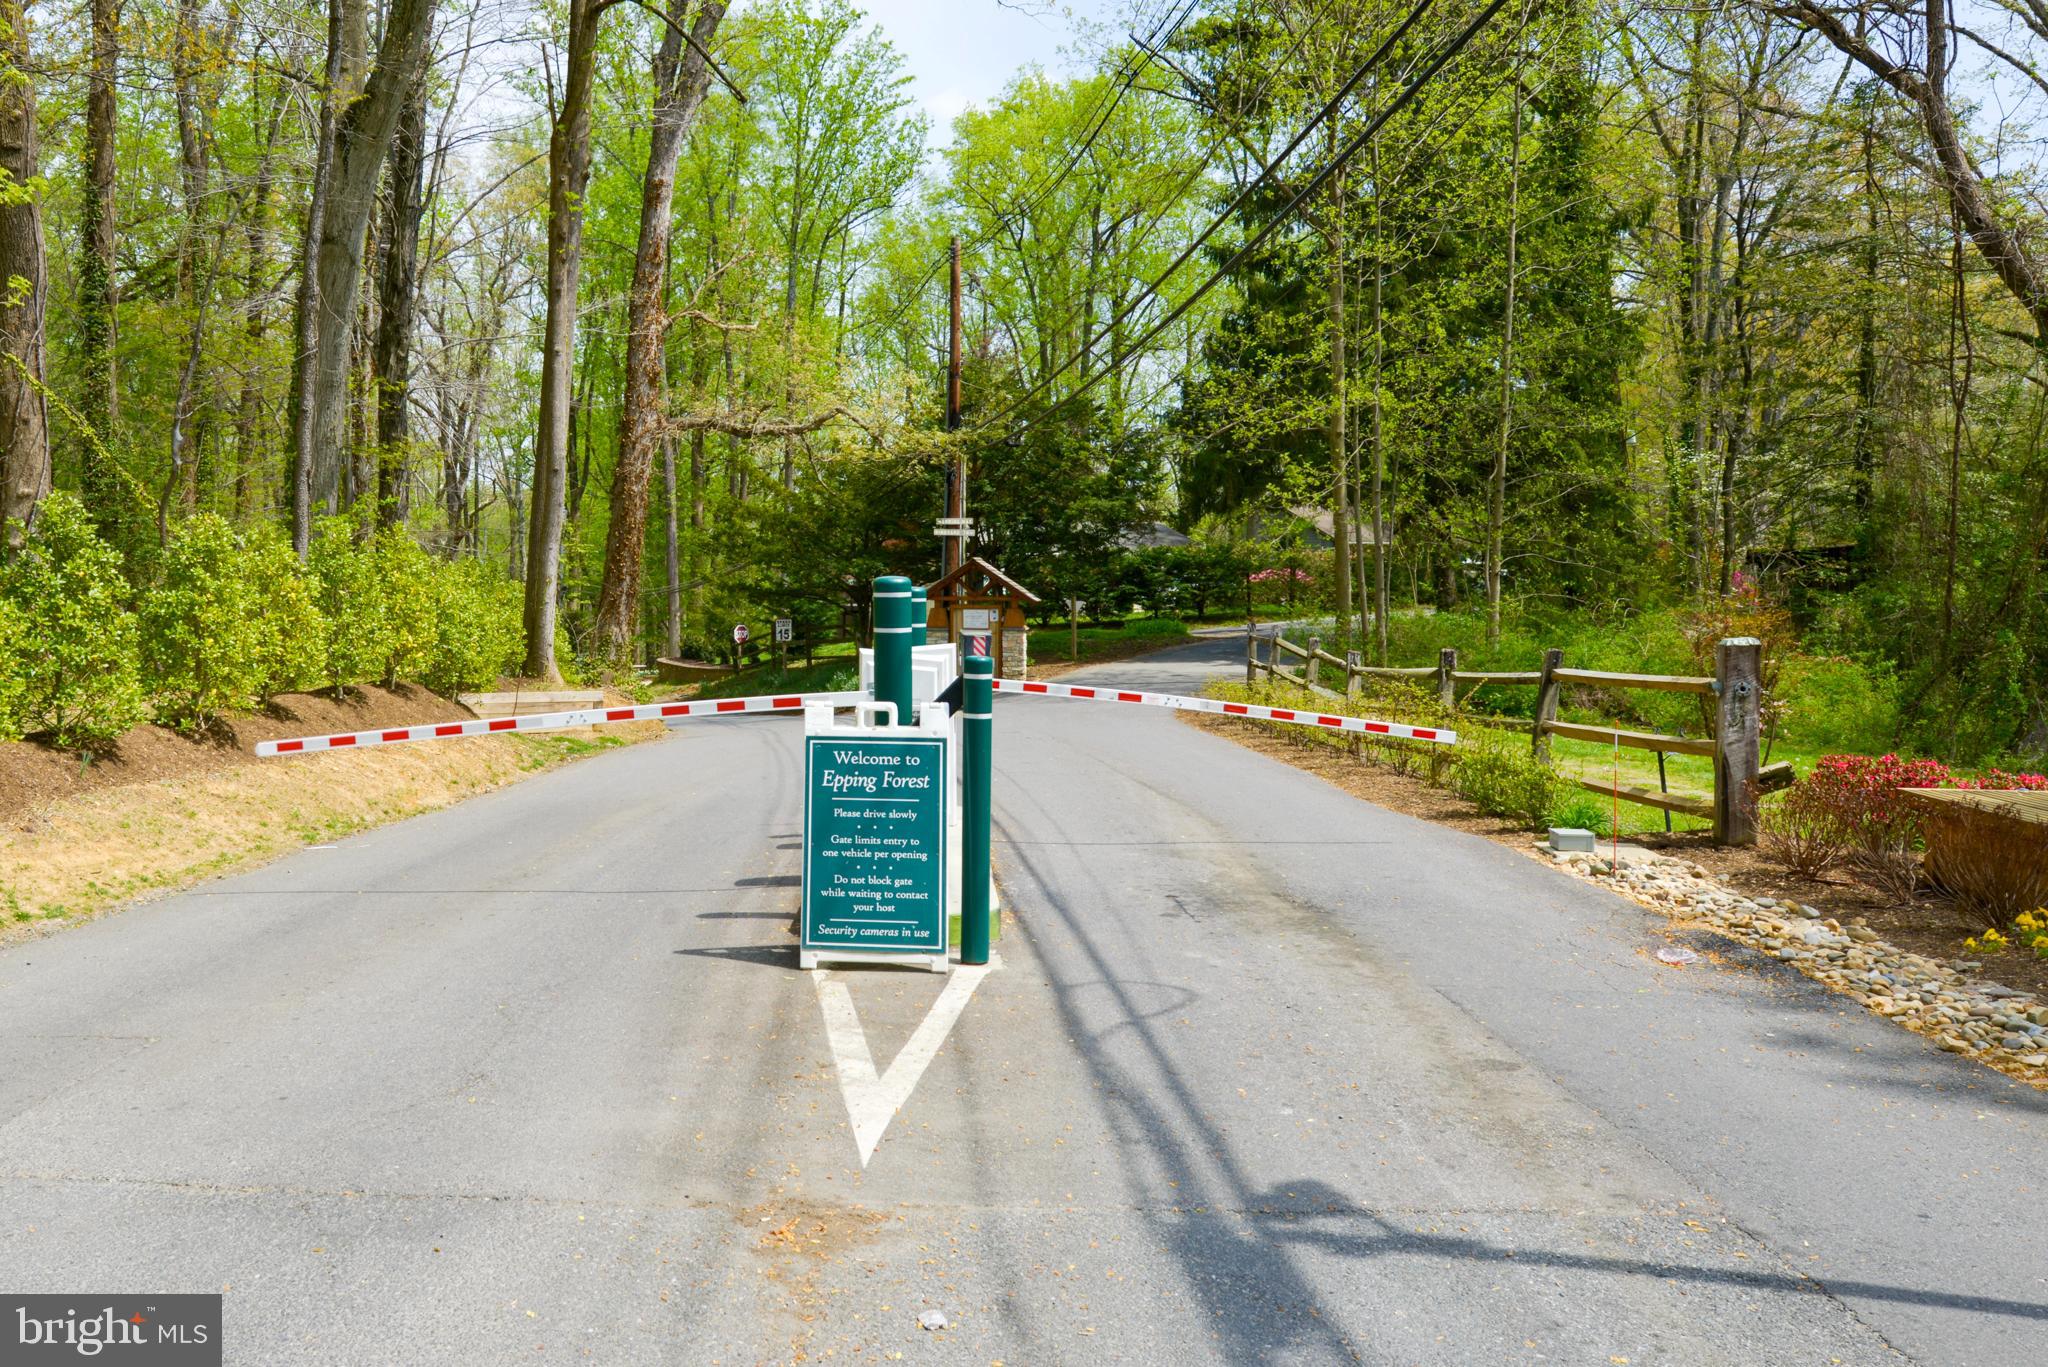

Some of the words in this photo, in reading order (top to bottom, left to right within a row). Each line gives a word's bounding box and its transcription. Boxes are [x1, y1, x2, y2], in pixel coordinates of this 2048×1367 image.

[779, 629, 790, 640] 15
[834, 751, 901, 766] Welcome
[906, 756, 921, 766] to
[822, 770, 877, 792] Epping
[883, 771, 930, 789] Forest
[834, 808, 861, 818] Please
[863, 809, 887, 818] drive
[889, 810, 918, 822] slowly
[831, 835, 853, 844] Gate
[855, 835, 882, 845] limits
[884, 839, 908, 848] entry
[842, 848, 872, 858] vehicle
[875, 852, 890, 861] per
[892, 851, 928, 862] opening
[835, 875, 849, 884] Do
[868, 875, 892, 885] block
[894, 879, 913, 888] gate
[821, 888, 846, 897] while
[848, 889, 882, 901] waiting
[854, 905, 875, 914] your
[877, 903, 896, 912] host
[818, 924, 858, 938] Security
[860, 929, 899, 937] cameras
[902, 928, 911, 937] in
